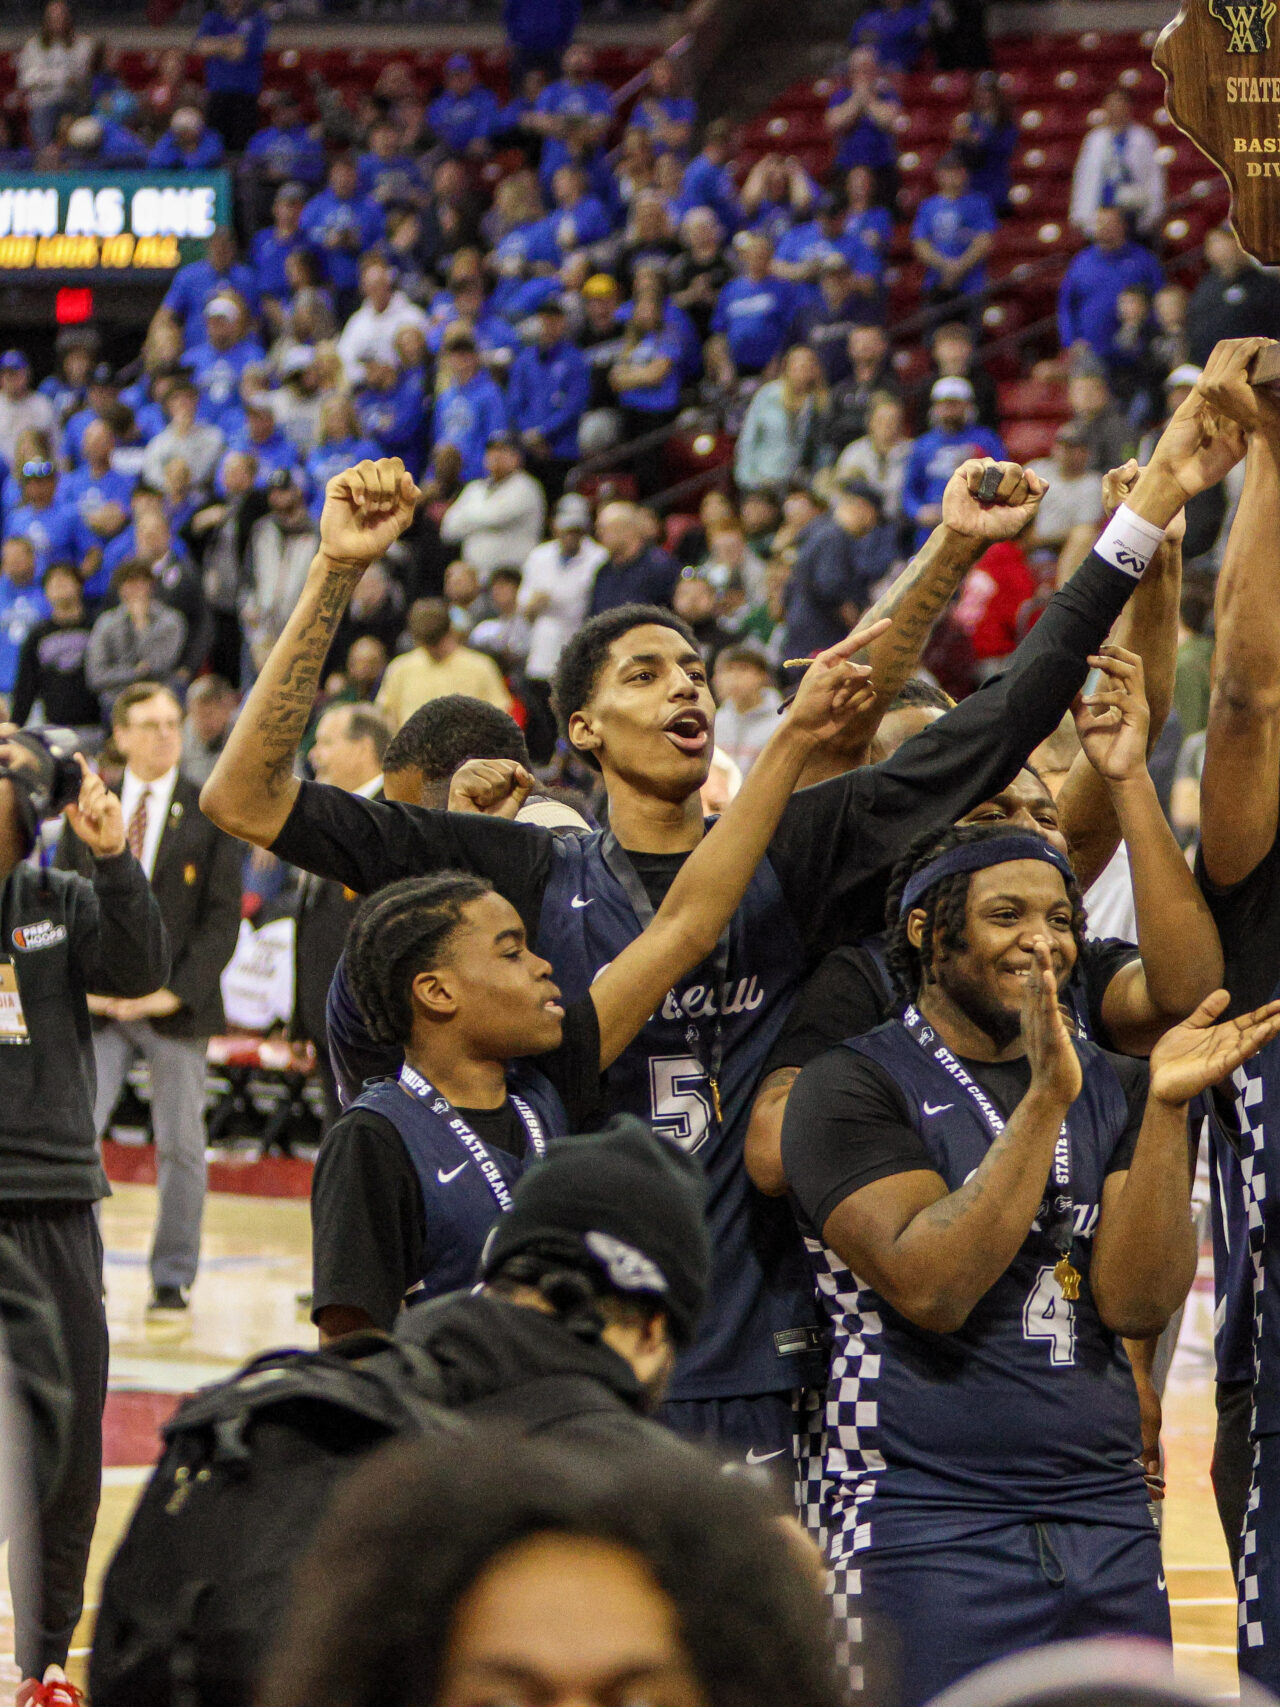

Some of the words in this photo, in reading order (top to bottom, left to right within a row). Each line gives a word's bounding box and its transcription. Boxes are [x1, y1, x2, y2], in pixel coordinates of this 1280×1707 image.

[65, 187, 125, 237] AS
[131, 187, 216, 238] ONE
[22, 922, 52, 938] PREP
[26, 928, 65, 949] HOOPS
[934, 1047, 974, 1086] STATE
[648, 1054, 712, 1156] 5
[450, 1118, 488, 1162] STATE
[1023, 1265, 1078, 1366] 4
